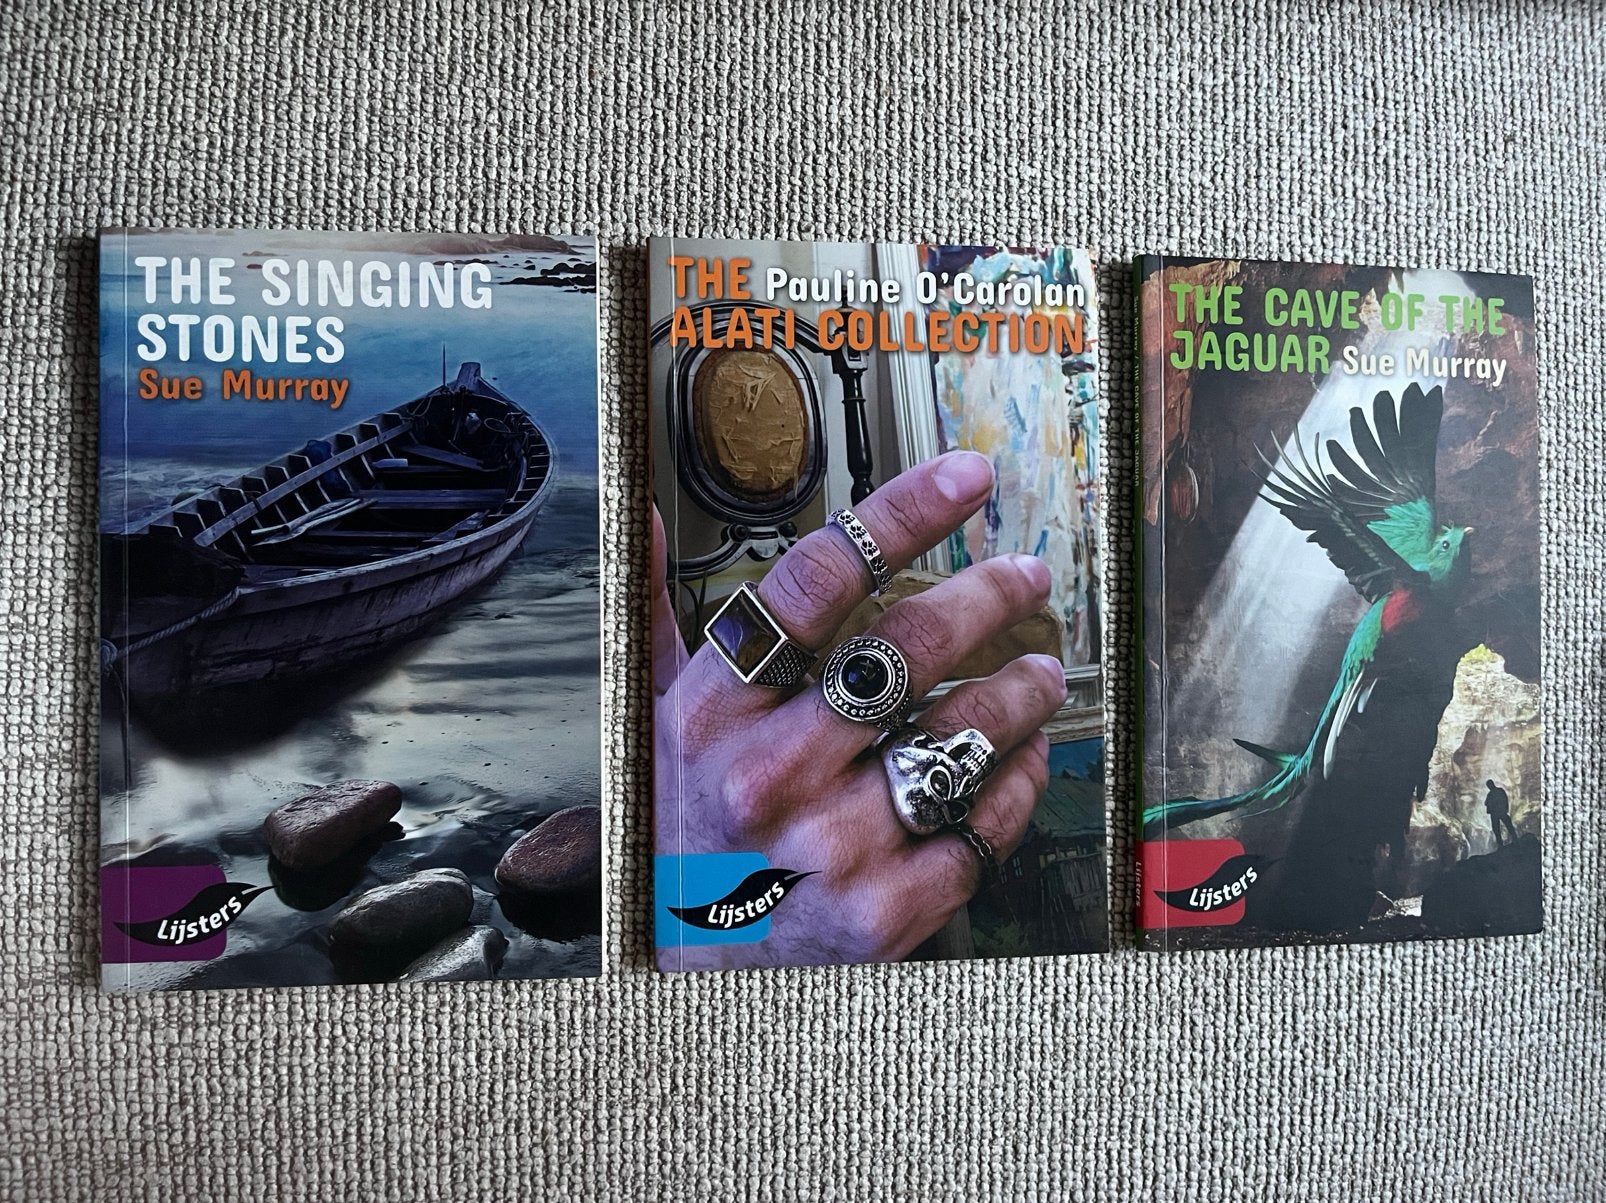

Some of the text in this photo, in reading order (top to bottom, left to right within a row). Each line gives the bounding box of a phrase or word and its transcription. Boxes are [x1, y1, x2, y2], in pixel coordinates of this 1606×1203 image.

[135, 257, 492, 309] THE SINGING
[668, 255, 751, 300] THE
[767, 267, 1085, 307] Pauline O'Carolan
[669, 306, 1083, 354] ALATI COLLECTION
[1169, 283, 1505, 336] THE CAVE OF THE
[137, 314, 344, 364] STONES
[1170, 330, 1329, 374] JAGUAR
[139, 368, 348, 409] Sue Murray
[1343, 346, 1507, 387] Sue Murray
[1134, 413, 1140, 426] OF
[708, 881, 784, 928] Lijsters
[1189, 867, 1258, 911] Lijsters
[157, 896, 242, 944] Lijsters
